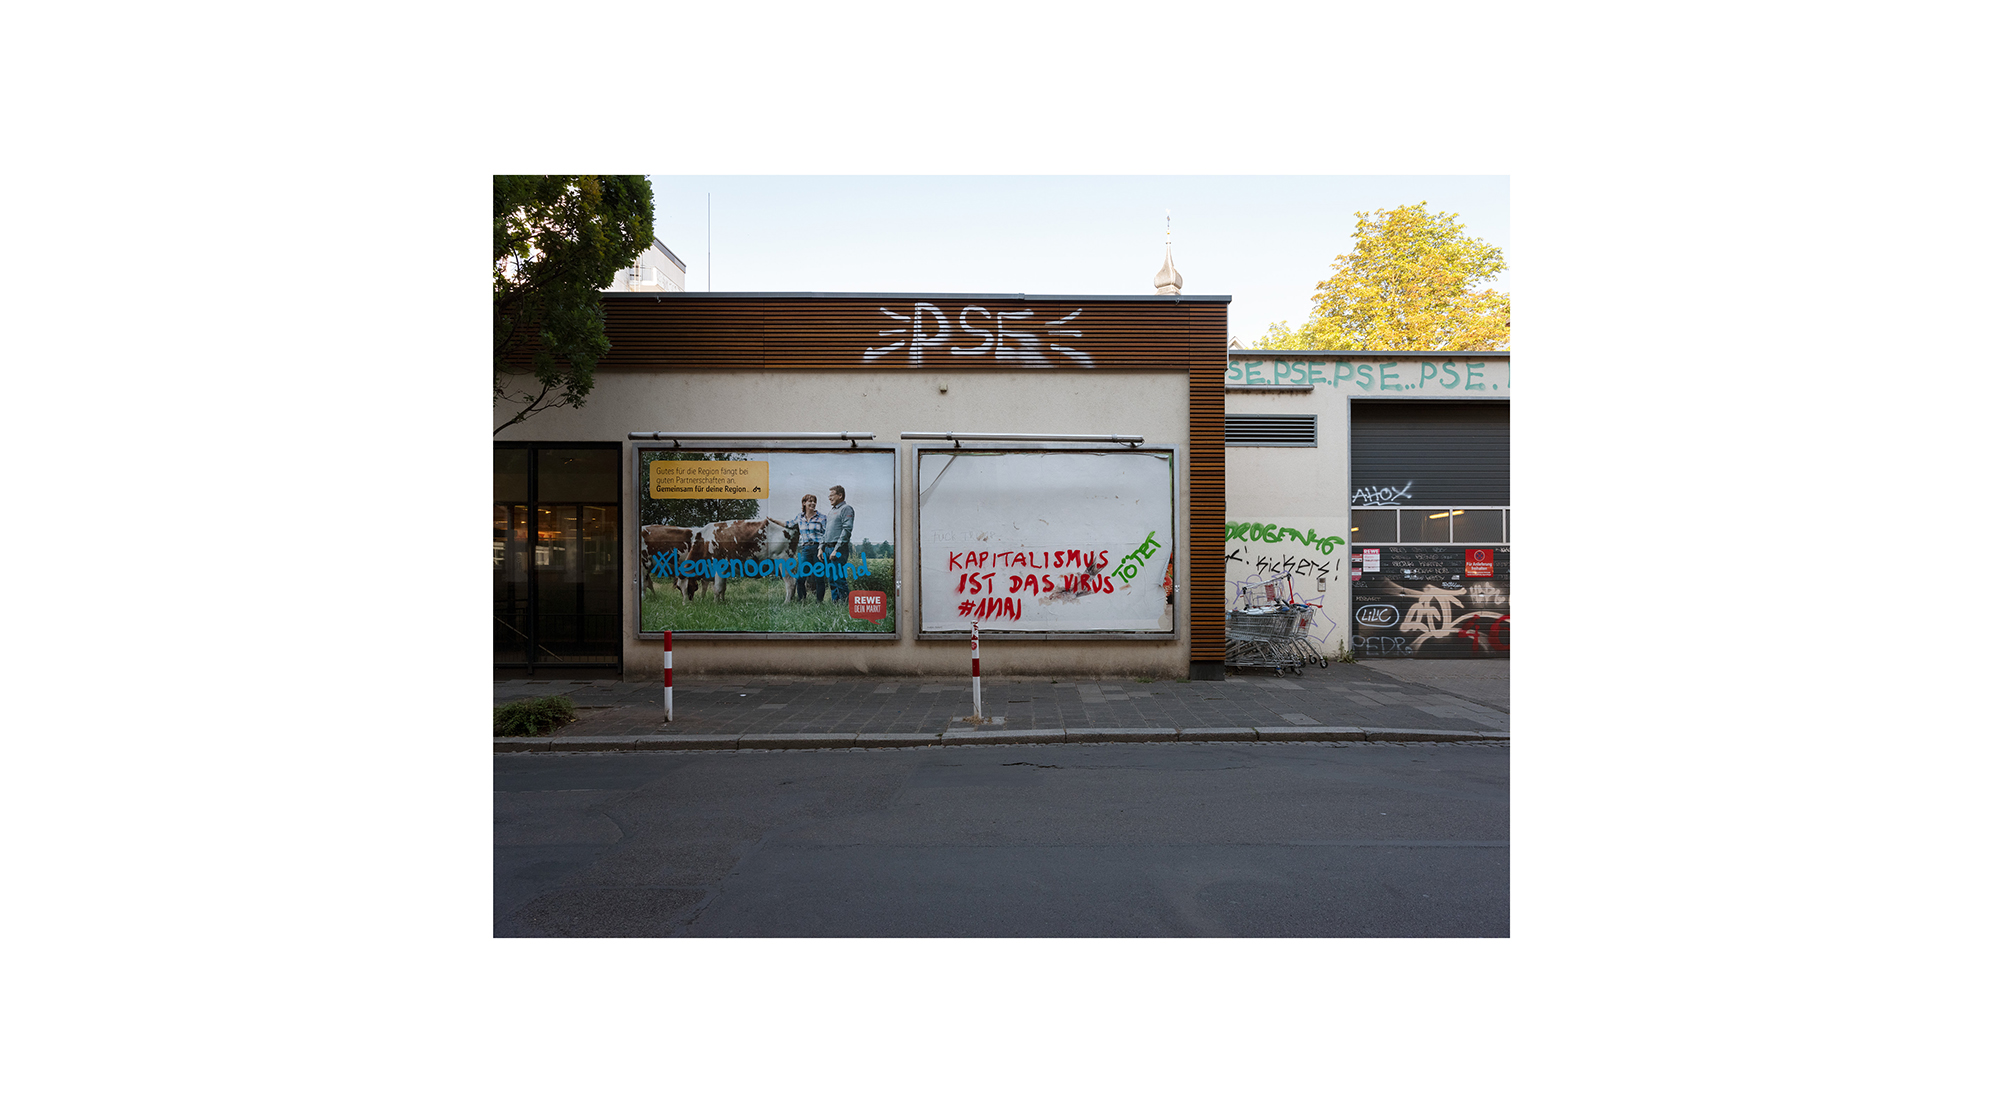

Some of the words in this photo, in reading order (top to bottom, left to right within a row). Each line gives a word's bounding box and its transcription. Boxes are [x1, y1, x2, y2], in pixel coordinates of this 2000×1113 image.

[656, 467, 674, 475] Gutes
[676, 467, 685, 475] für
[687, 467, 695, 475] die
[698, 467, 719, 477] Region
[720, 467, 738, 477] fängt
[739, 467, 749, 475] bei
[656, 478, 674, 486] guten
[676, 477, 725, 485] Partnerschaften
[656, 485, 693, 493] Gemeinsam
[695, 485, 704, 493] für
[949, 549, 1109, 571] KAPITALISMUS
[1111, 530, 1161, 583] TÖTET
[957, 572, 996, 595] IST
[1009, 573, 1055, 596] DAS
[1063, 573, 1115, 595] VIRUS
[854, 596, 881, 604] REWE
[854, 605, 866, 613] DEIN
[866, 605, 881, 613] MARKT
